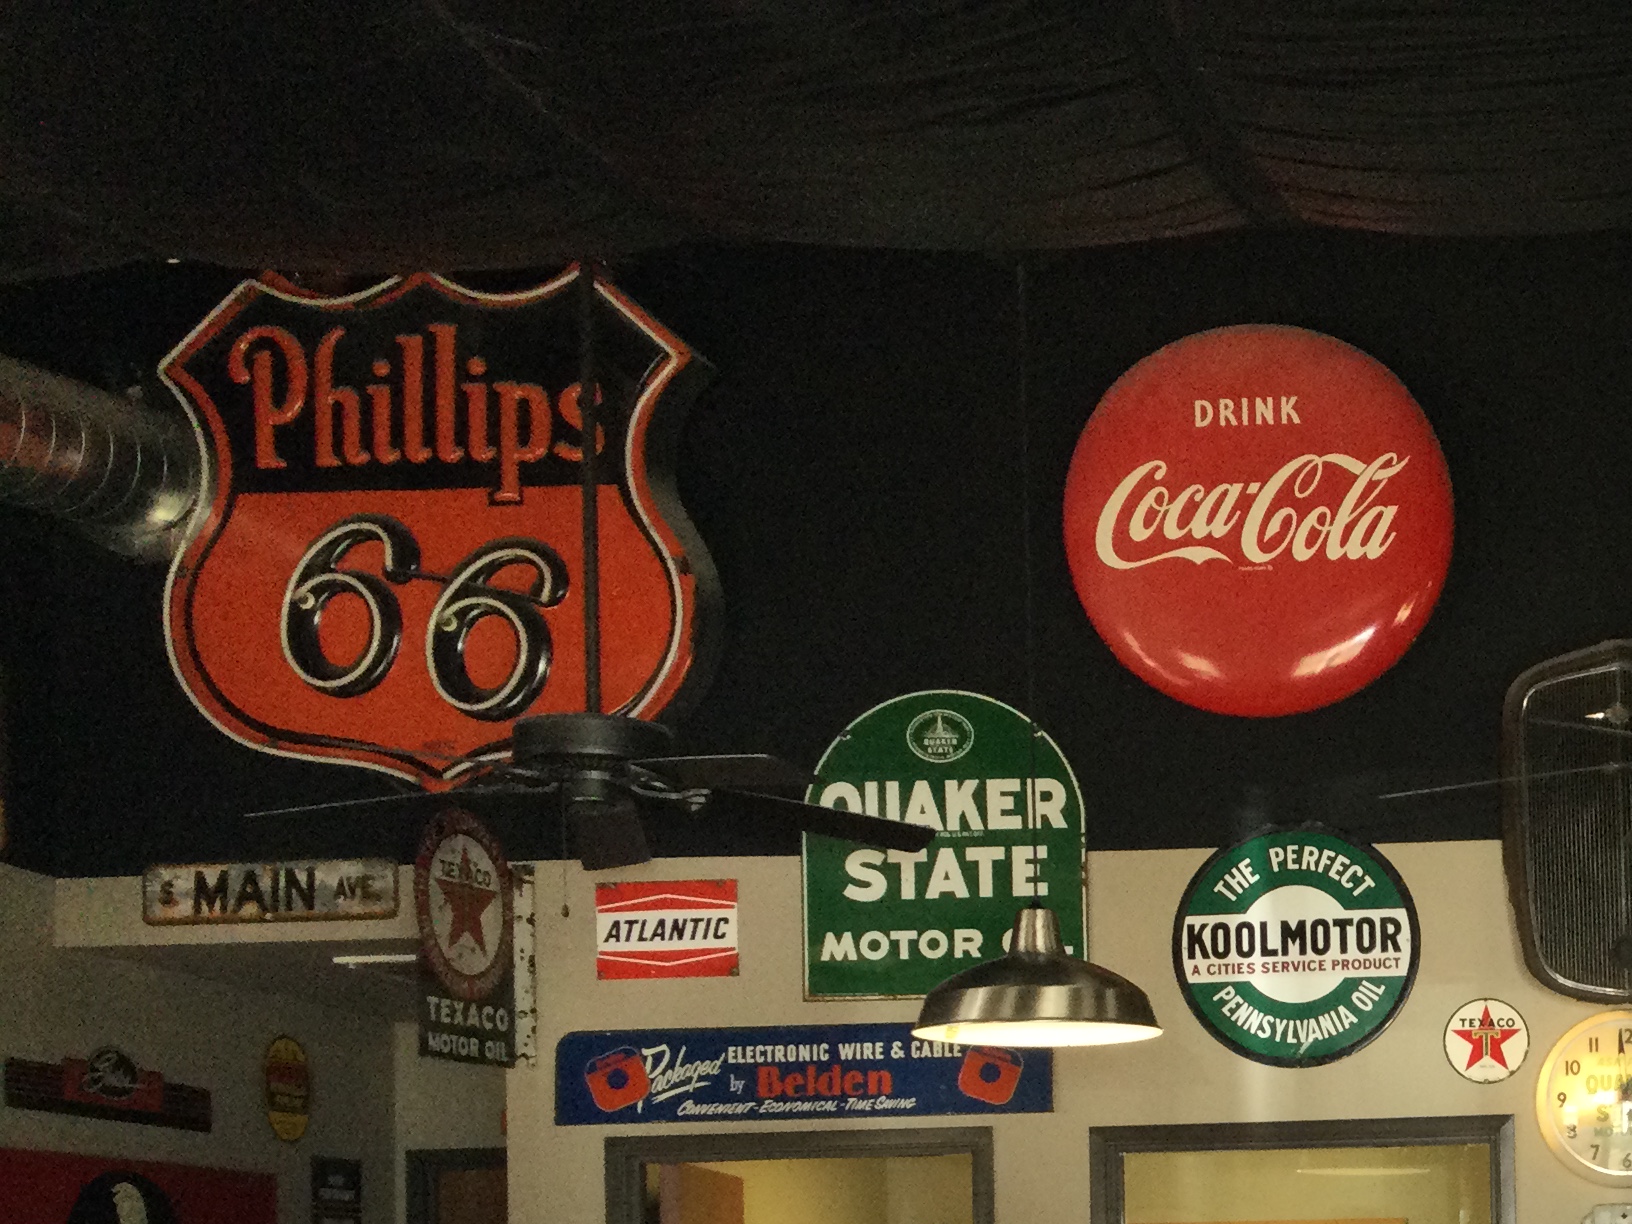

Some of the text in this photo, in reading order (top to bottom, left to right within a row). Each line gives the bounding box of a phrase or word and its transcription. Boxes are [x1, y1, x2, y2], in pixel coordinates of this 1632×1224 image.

[228, 323, 605, 506] Phillips
[1194, 396, 1301, 428] DRINK
[1095, 452, 1411, 570] Coca-Cola
[280, 514, 570, 721] 66
[192, 866, 316, 915] MAIN
[842, 844, 1049, 902] STATE
[1213, 844, 1376, 901] THE PERFECT
[603, 917, 730, 944] ATLANTIC
[820, 928, 983, 962] MOTOR
[1186, 916, 1403, 960] KOOLMOTOR
[1191, 957, 1402, 976] A CITIES SERVICE PRODUCT
[425, 995, 510, 1032] TEXACO
[1212, 979, 1386, 1045] PENNSYLVANIA OIL
[1459, 1016, 1516, 1029] TEXACO
[427, 1031, 480, 1057] MOTOR
[728, 1040, 962, 1064] ELECTRONIC WIRE & CABLE
[729, 1064, 893, 1098] by Belden
